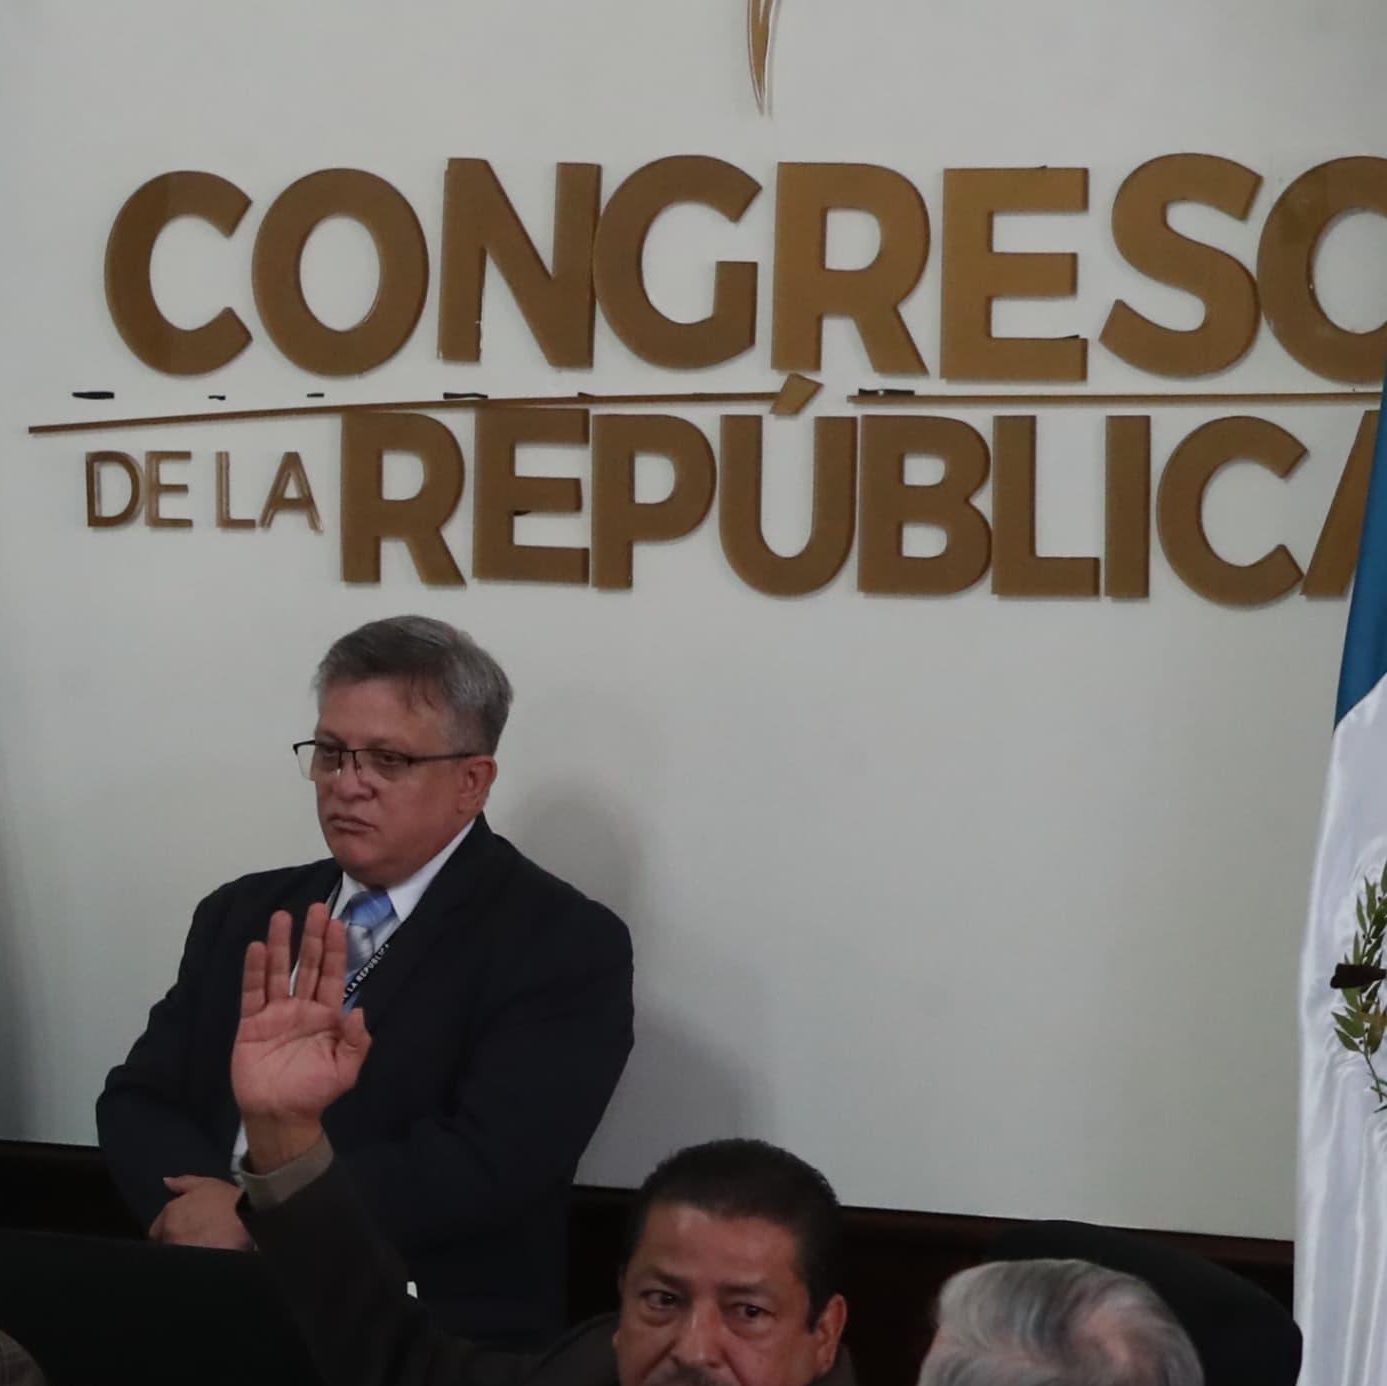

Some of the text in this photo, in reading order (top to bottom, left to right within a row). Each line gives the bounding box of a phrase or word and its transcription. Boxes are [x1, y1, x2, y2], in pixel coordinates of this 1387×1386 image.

[104, 153, 1387, 381] CONGRESO
[85, 450, 193, 528] DE
[215, 450, 322, 531] LA
